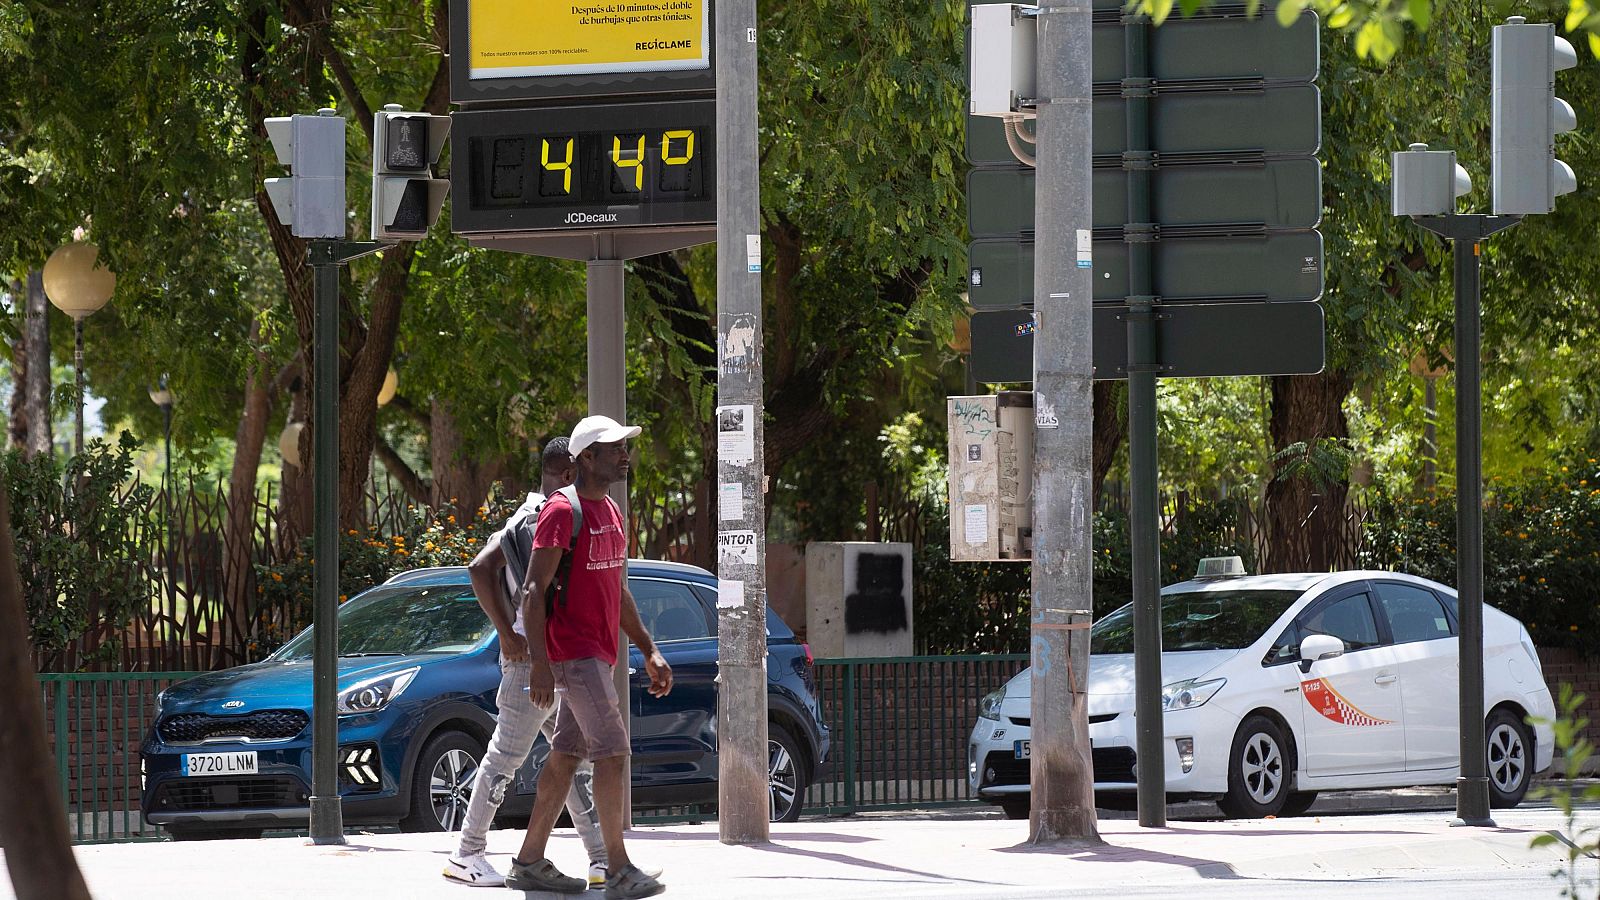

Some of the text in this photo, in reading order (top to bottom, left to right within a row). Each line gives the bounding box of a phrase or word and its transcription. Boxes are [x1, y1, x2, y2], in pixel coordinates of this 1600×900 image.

[571, 1, 692, 16] Después de 10 minutos, el doble
[579, 11, 692, 25] de burbujas que otras tónicas.
[564, 212, 617, 224] JCDecaux
[190, 754, 254, 772] 3720 LNM
